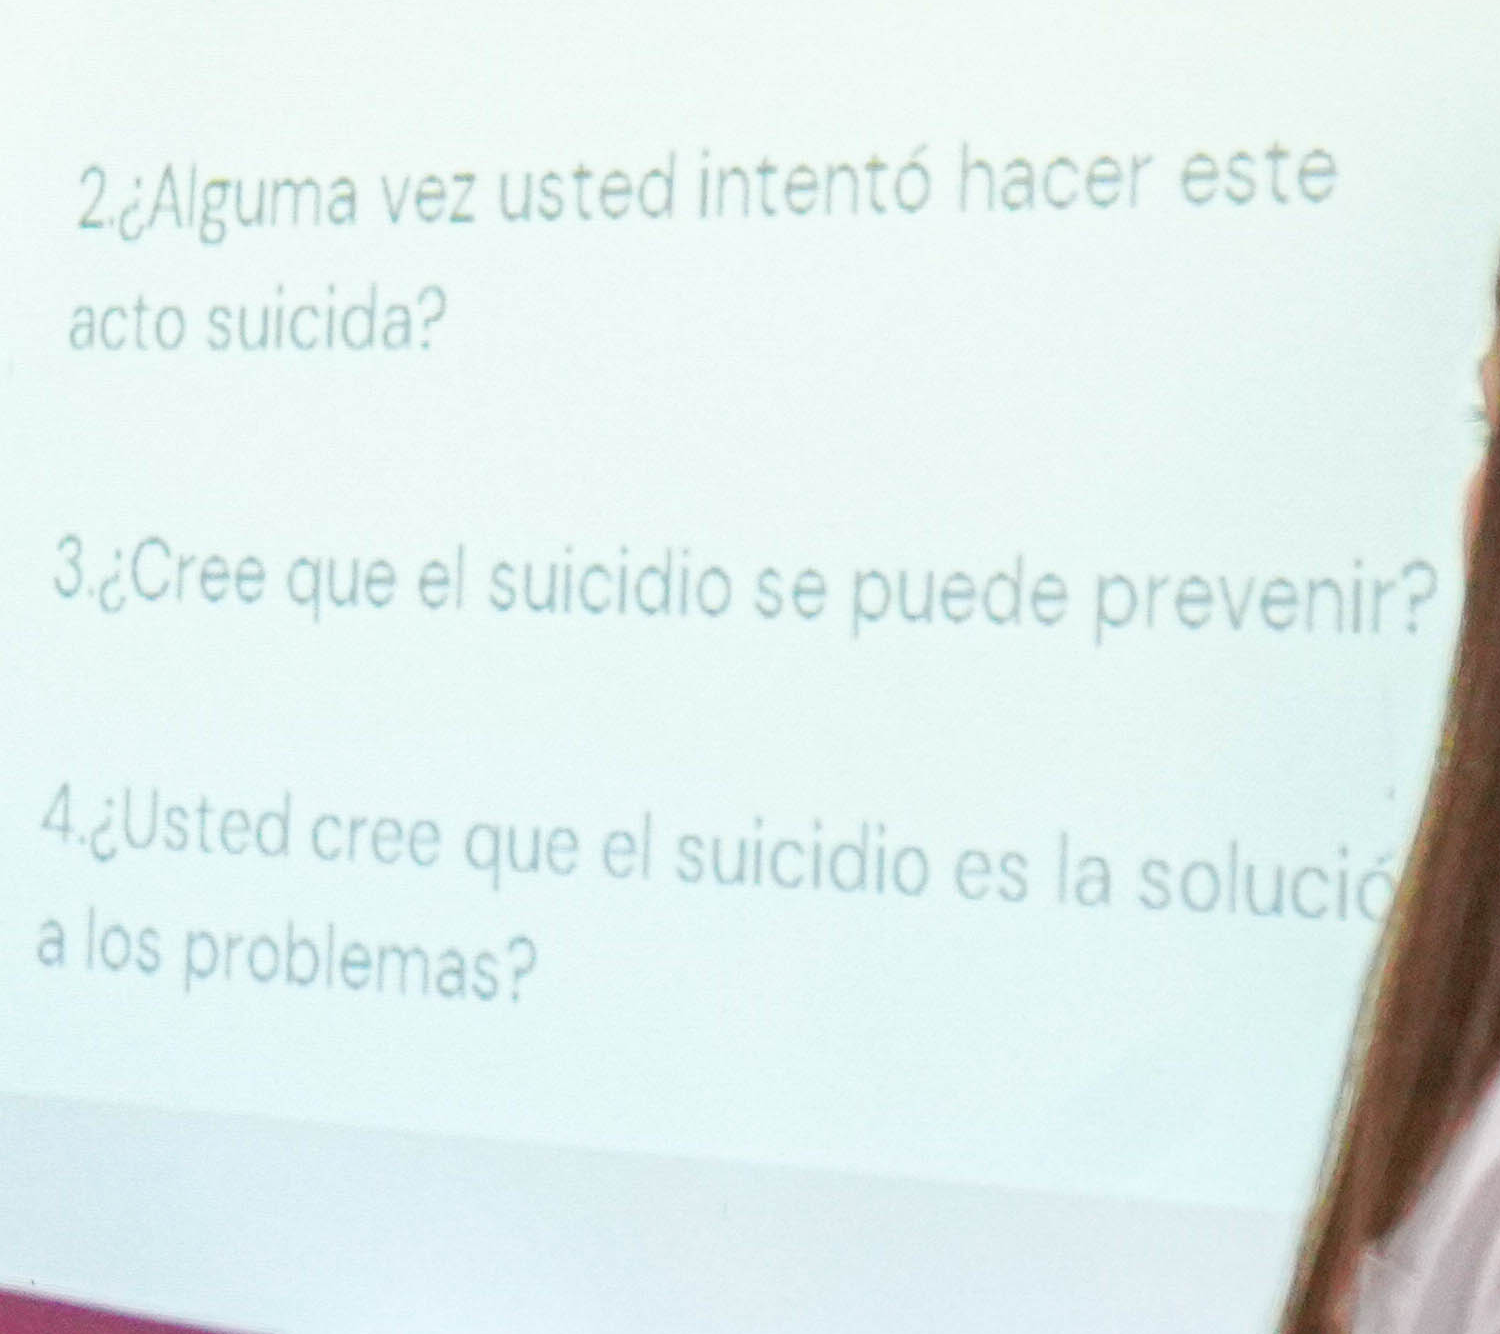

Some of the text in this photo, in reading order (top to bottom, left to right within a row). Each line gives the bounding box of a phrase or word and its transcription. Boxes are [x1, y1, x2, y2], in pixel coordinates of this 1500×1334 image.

[378, 169, 479, 227] vez
[497, 148, 679, 225] usted
[696, 141, 934, 221] intentó
[957, 140, 1155, 214] hacer
[1177, 139, 1340, 209] este
[66, 281, 449, 354] acto suicida?
[284, 553, 400, 625] que
[415, 542, 467, 613] el
[486, 543, 734, 620] suicidio
[752, 564, 830, 623] se
[850, 552, 1071, 640] puede
[1092, 555, 1440, 649] prevenir?
[308, 811, 443, 870] cree
[462, 820, 582, 894] que
[599, 809, 654, 881] el
[674, 814, 932, 899] suicidio
[952, 847, 1030, 905] es
[1056, 829, 1114, 909] la
[34, 904, 539, 1005] a los problemas?
